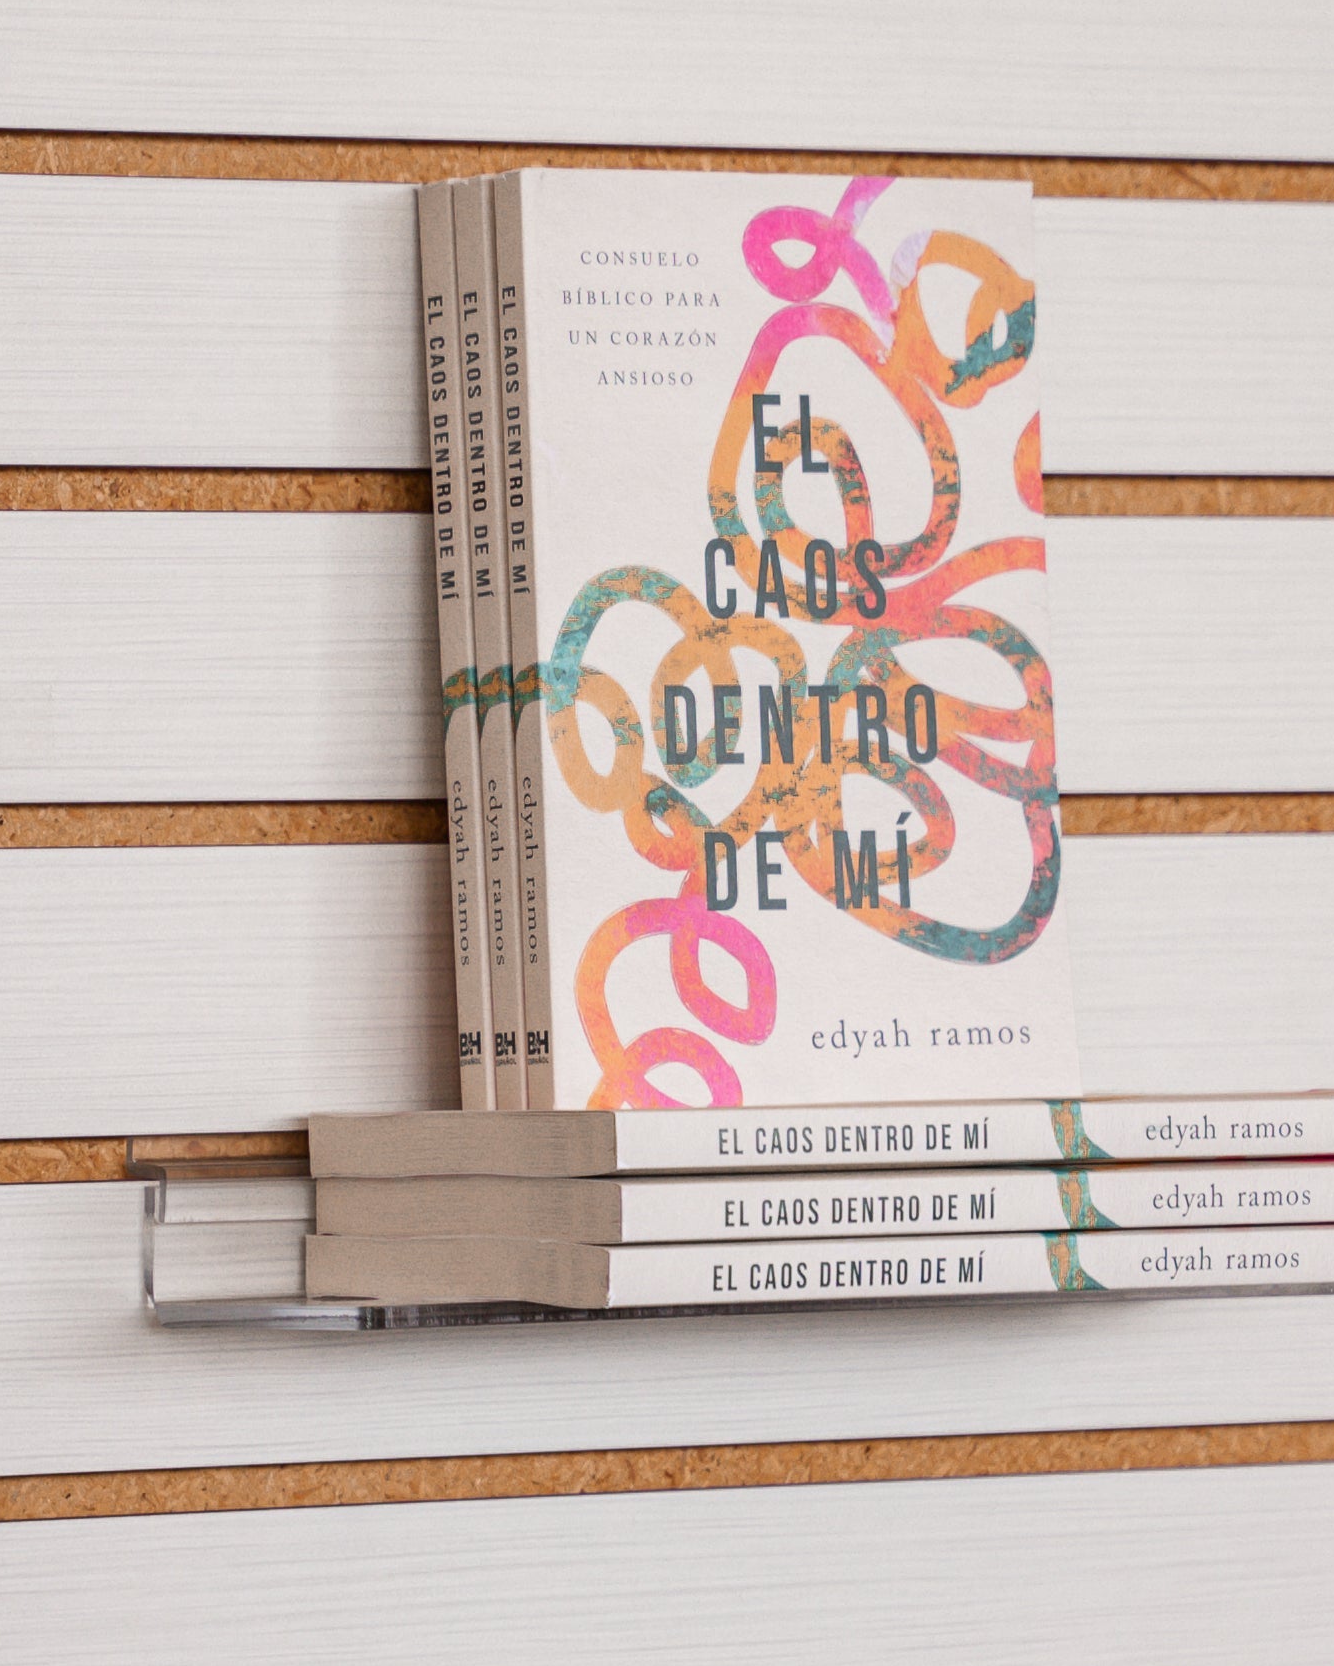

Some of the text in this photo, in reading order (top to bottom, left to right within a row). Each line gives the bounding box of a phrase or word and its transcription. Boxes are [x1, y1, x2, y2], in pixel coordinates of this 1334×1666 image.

[580, 249, 700, 268] CONSUELO
[561, 288, 722, 308] BÍBLICO PARA
[568, 326, 719, 348] UN CORAZÓN
[596, 370, 694, 387] ANSIOSO
[502, 285, 531, 595] EL CAOS DENTRO DE MÍ
[752, 393, 829, 474] EL
[704, 537, 888, 619] CAOS
[664, 683, 940, 765] DENTRO
[522, 775, 539, 965] edyah ramos
[704, 812, 912, 911] DE MÍ
[811, 1020, 1032, 1057] edyah ramos
[718, 1116, 989, 1156] EL CAOS DENTRO DE MÍ
[1144, 1116, 1304, 1144] edyah ramos
[724, 1187, 996, 1228] EL CAOS DENTRO DE MÍ
[1152, 1184, 1311, 1212] edyah ramos
[712, 1250, 985, 1292] EL CAOS DENTRO DE MÍ
[1140, 1248, 1301, 1276] edyah ramos
